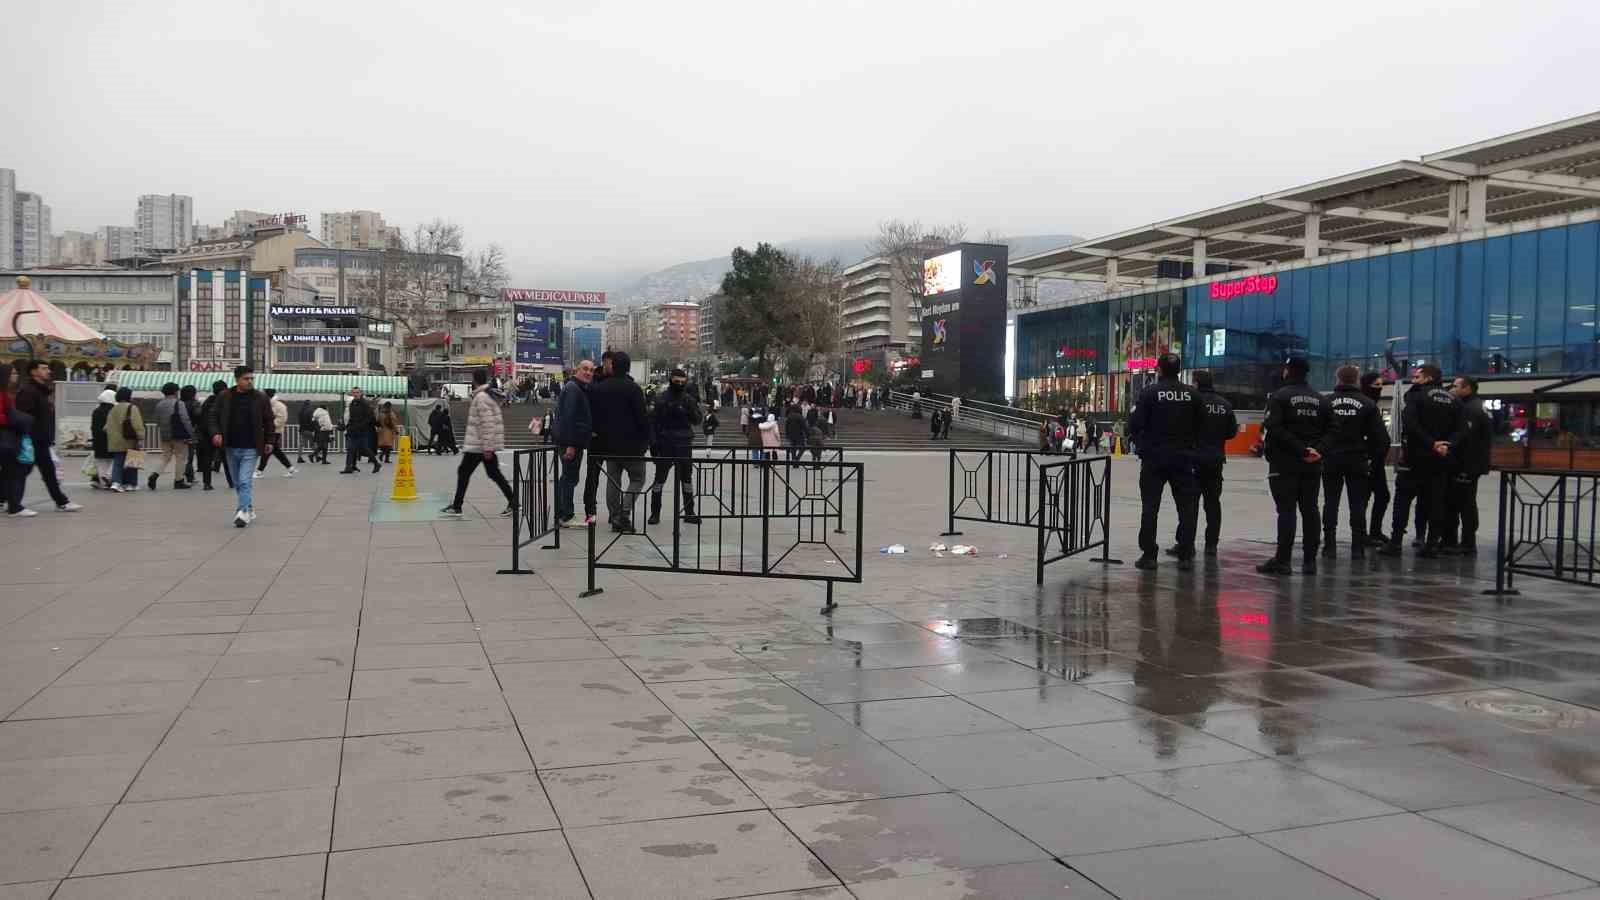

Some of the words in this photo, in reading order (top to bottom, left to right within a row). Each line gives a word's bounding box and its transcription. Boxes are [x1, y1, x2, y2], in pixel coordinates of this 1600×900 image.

[1210, 275, 1278, 301] SuperStep
[271, 306, 294, 315] ARAF
[271, 334, 291, 342] ARAF
[327, 335, 352, 343] KEBAP
